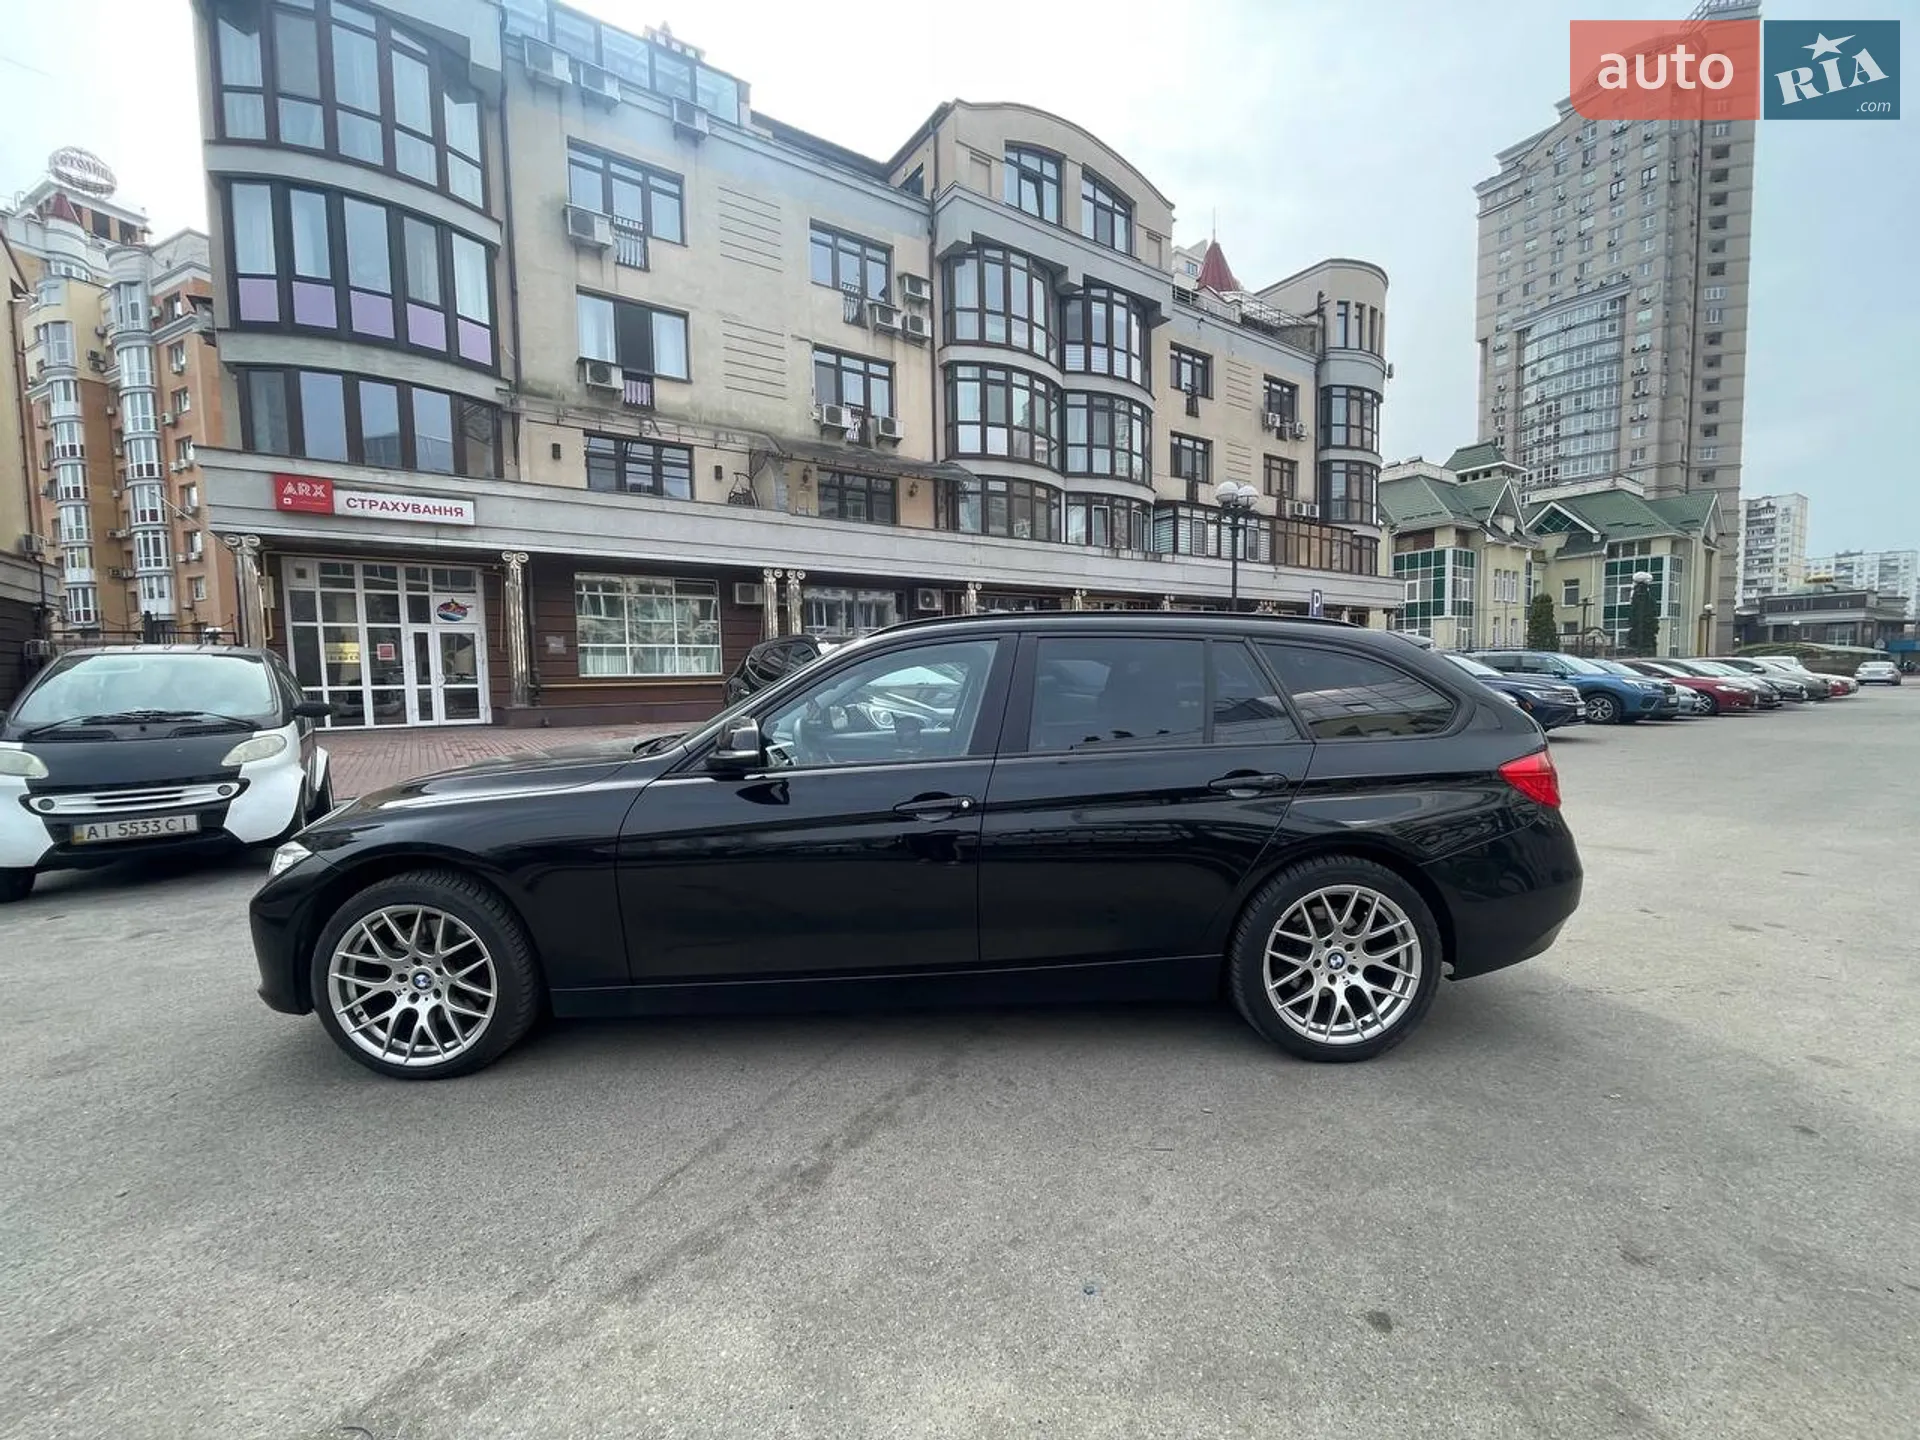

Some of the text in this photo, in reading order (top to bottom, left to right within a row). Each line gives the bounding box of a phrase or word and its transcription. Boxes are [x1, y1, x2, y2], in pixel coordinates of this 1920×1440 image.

[283, 481, 326, 497] ARX
[346, 497, 464, 517] СТРАХУВАННЯ
[1313, 591, 1321, 615] P
